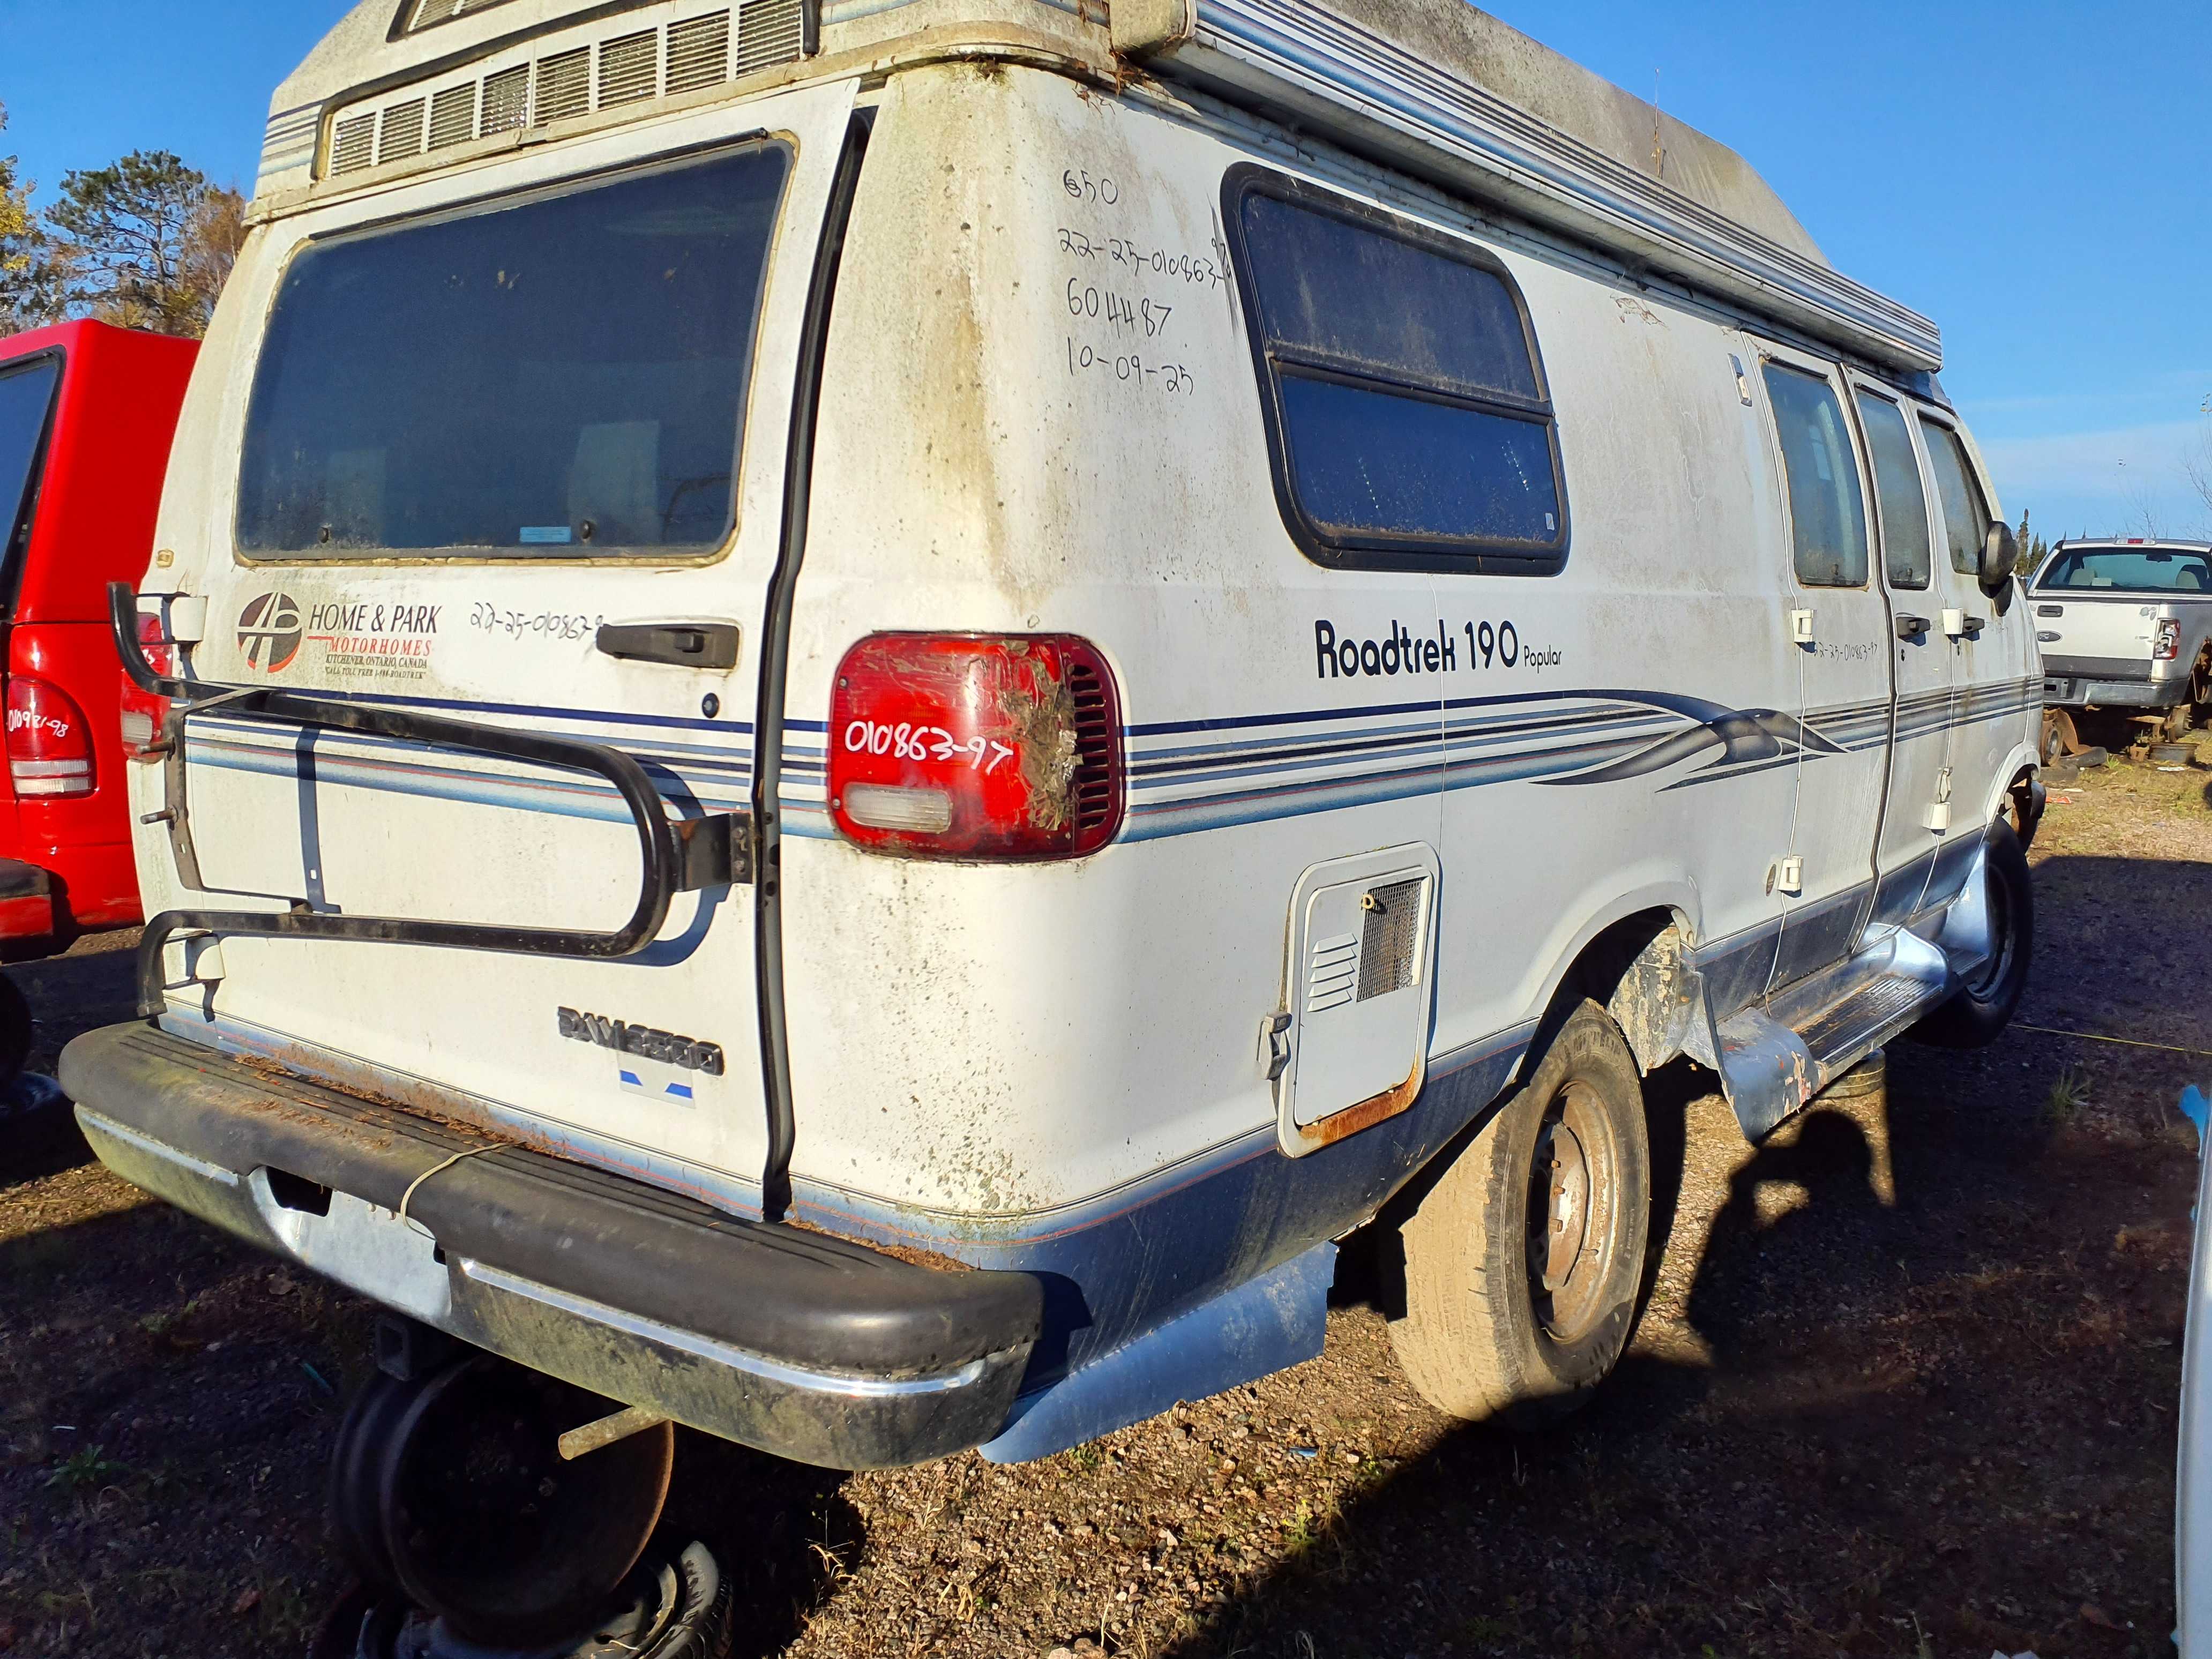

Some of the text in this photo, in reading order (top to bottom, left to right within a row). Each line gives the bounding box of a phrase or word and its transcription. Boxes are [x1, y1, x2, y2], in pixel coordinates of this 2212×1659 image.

[1067, 278, 1172, 339] 604487
[1067, 337, 1194, 395] 10-09-25
[309, 604, 443, 633] HOME & PARK
[328, 636, 432, 657] MOTORHOMES
[398, 657, 428, 669] CANADA
[1314, 619, 1562, 679] Roadtrek 190 Popular
[357, 668, 373, 677] FREE
[845, 721, 1014, 775] 010863-97
